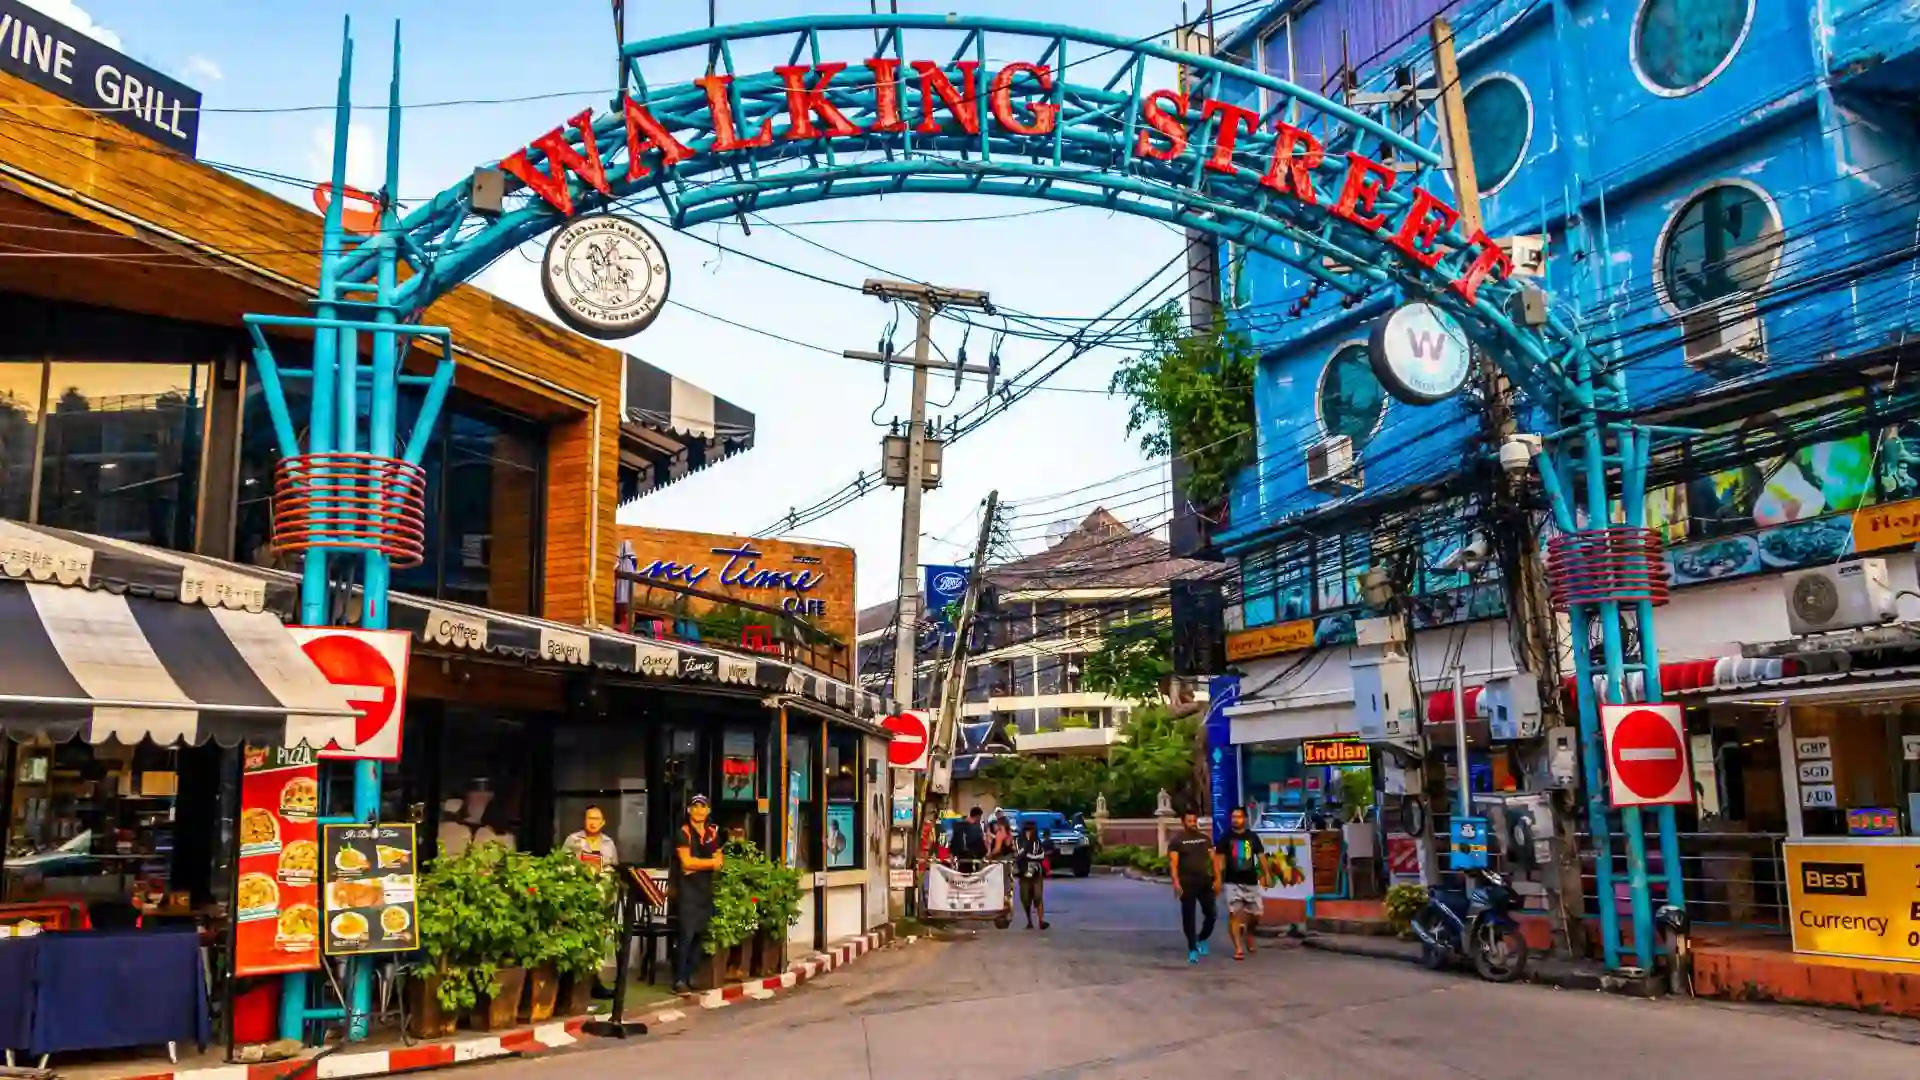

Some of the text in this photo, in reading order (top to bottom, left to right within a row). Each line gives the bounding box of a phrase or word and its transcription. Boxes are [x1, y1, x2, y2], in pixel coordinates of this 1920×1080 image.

[95, 64, 187, 140] GRILL
[499, 58, 1515, 305] WALKING STREET
[1407, 326, 1446, 361] W
[783, 596, 826, 616] CAFE
[439, 620, 478, 641] Coffee
[547, 640, 581, 657] Bakery
[728, 663, 748, 677] Wine
[1305, 742, 1368, 761] Indian
[1800, 742, 1827, 754] GBP
[1802, 765, 1830, 778] SGD
[1805, 790, 1833, 803] AUD
[1805, 869, 1862, 890] BEST
[1799, 909, 1889, 937] Currency
